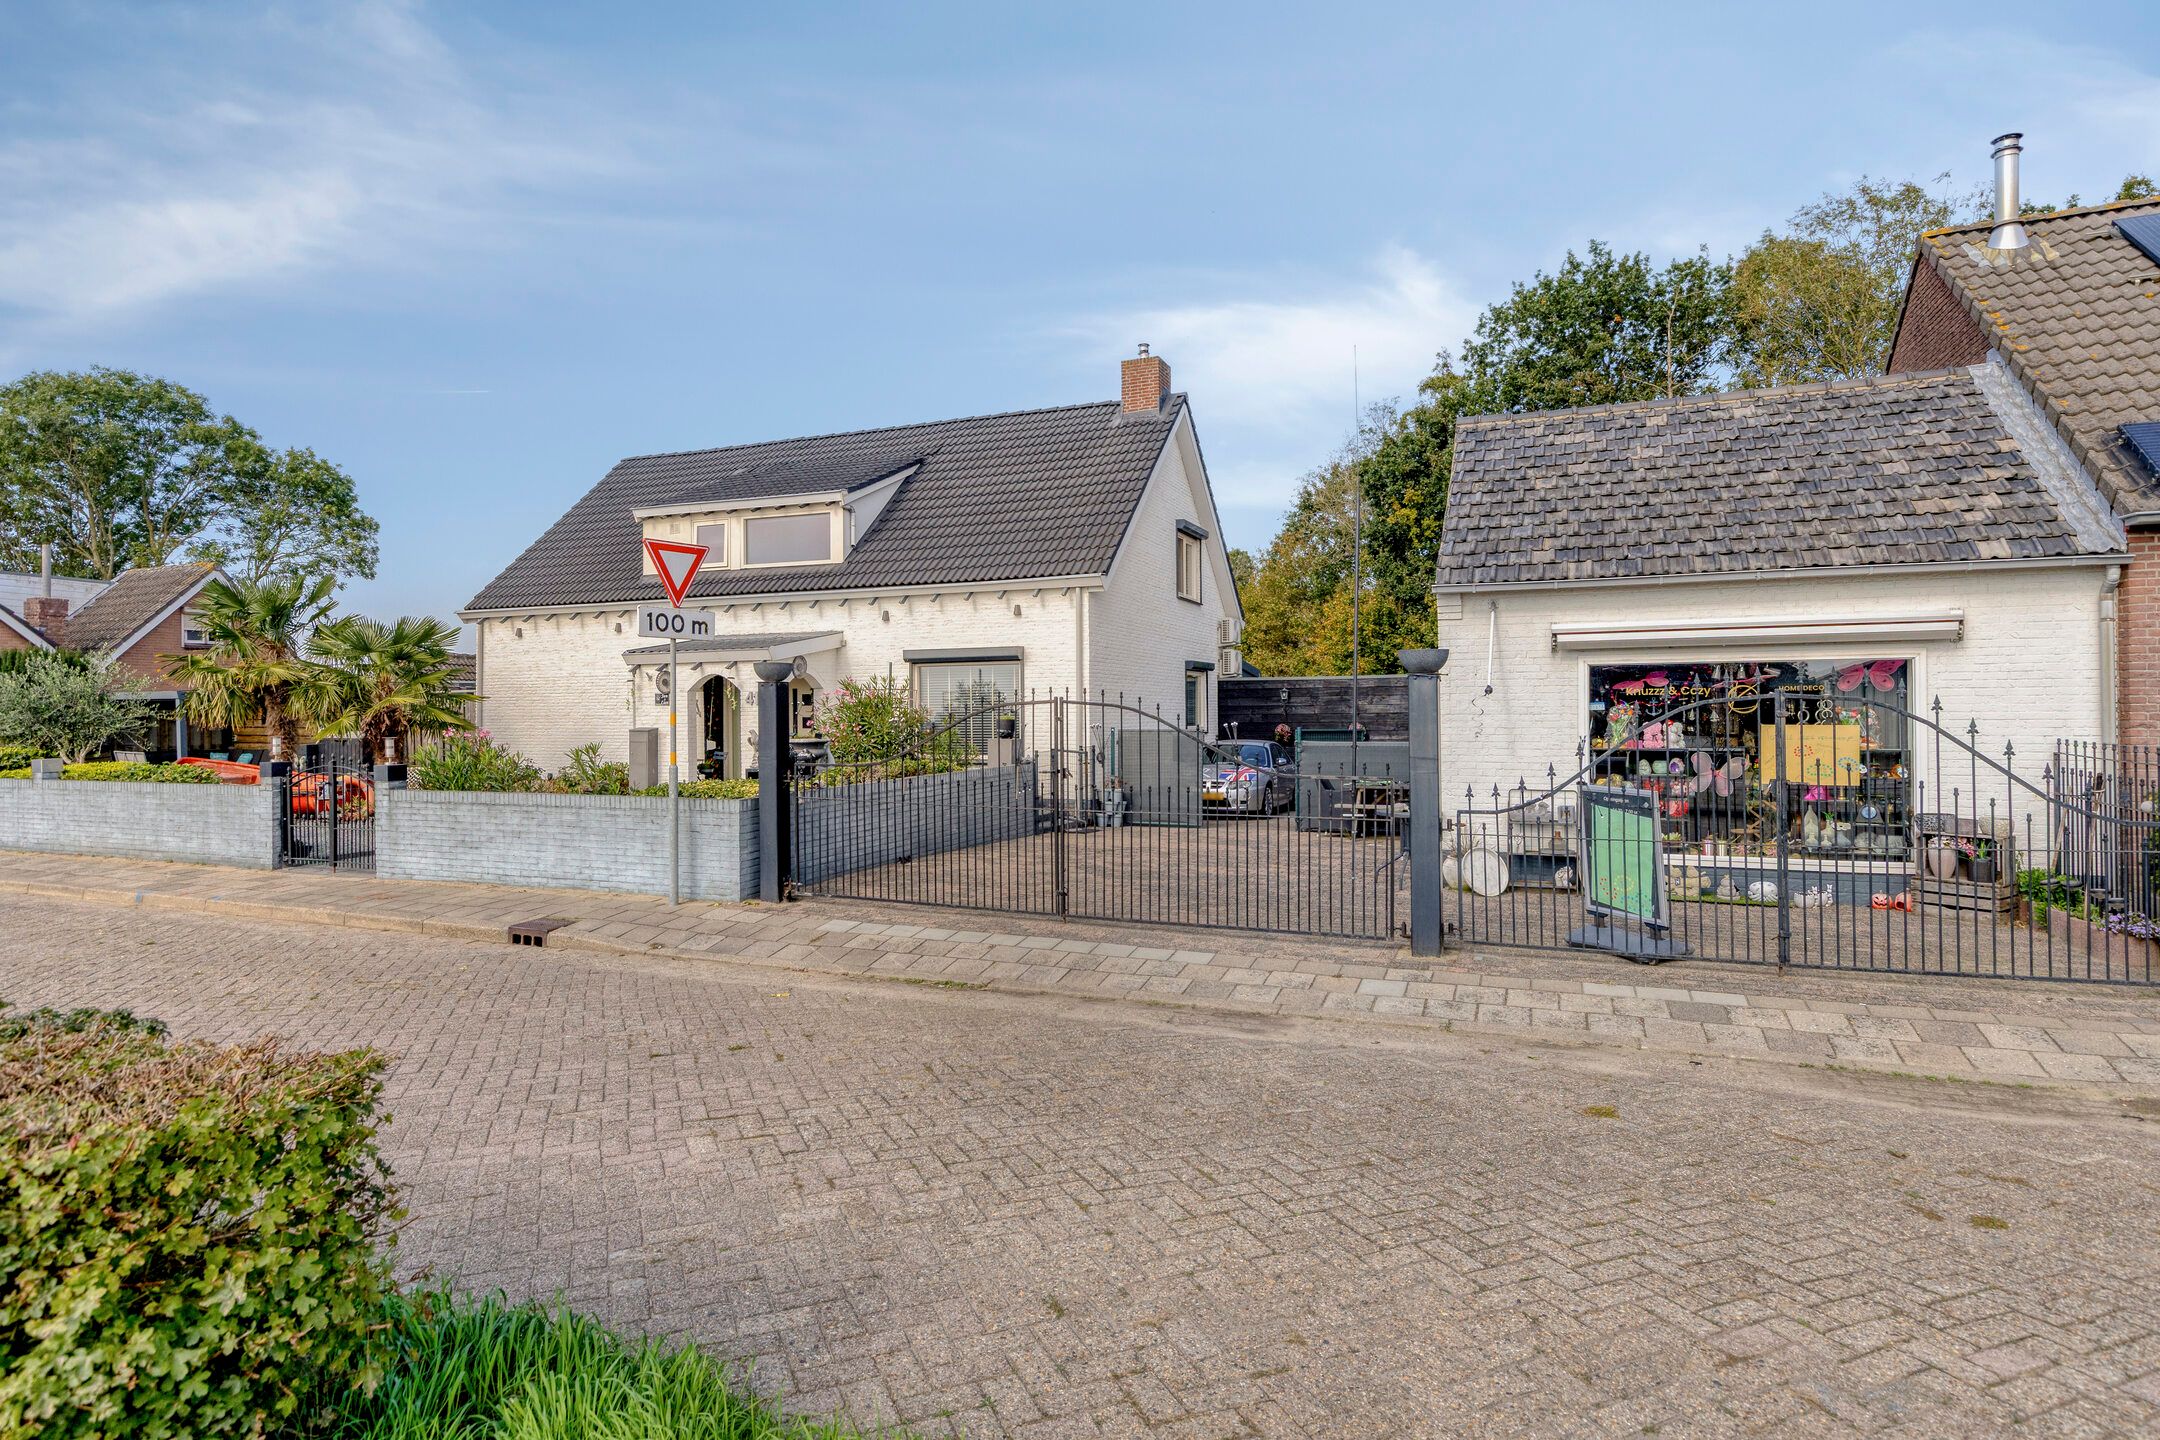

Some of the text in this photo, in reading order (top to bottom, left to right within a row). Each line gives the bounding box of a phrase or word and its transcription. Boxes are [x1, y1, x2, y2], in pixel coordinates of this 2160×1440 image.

[646, 612, 708, 635] 100 m
[1626, 686, 1665, 696] Knuzzz
[1668, 686, 1678, 695] &
[1779, 684, 1801, 692] HOME
